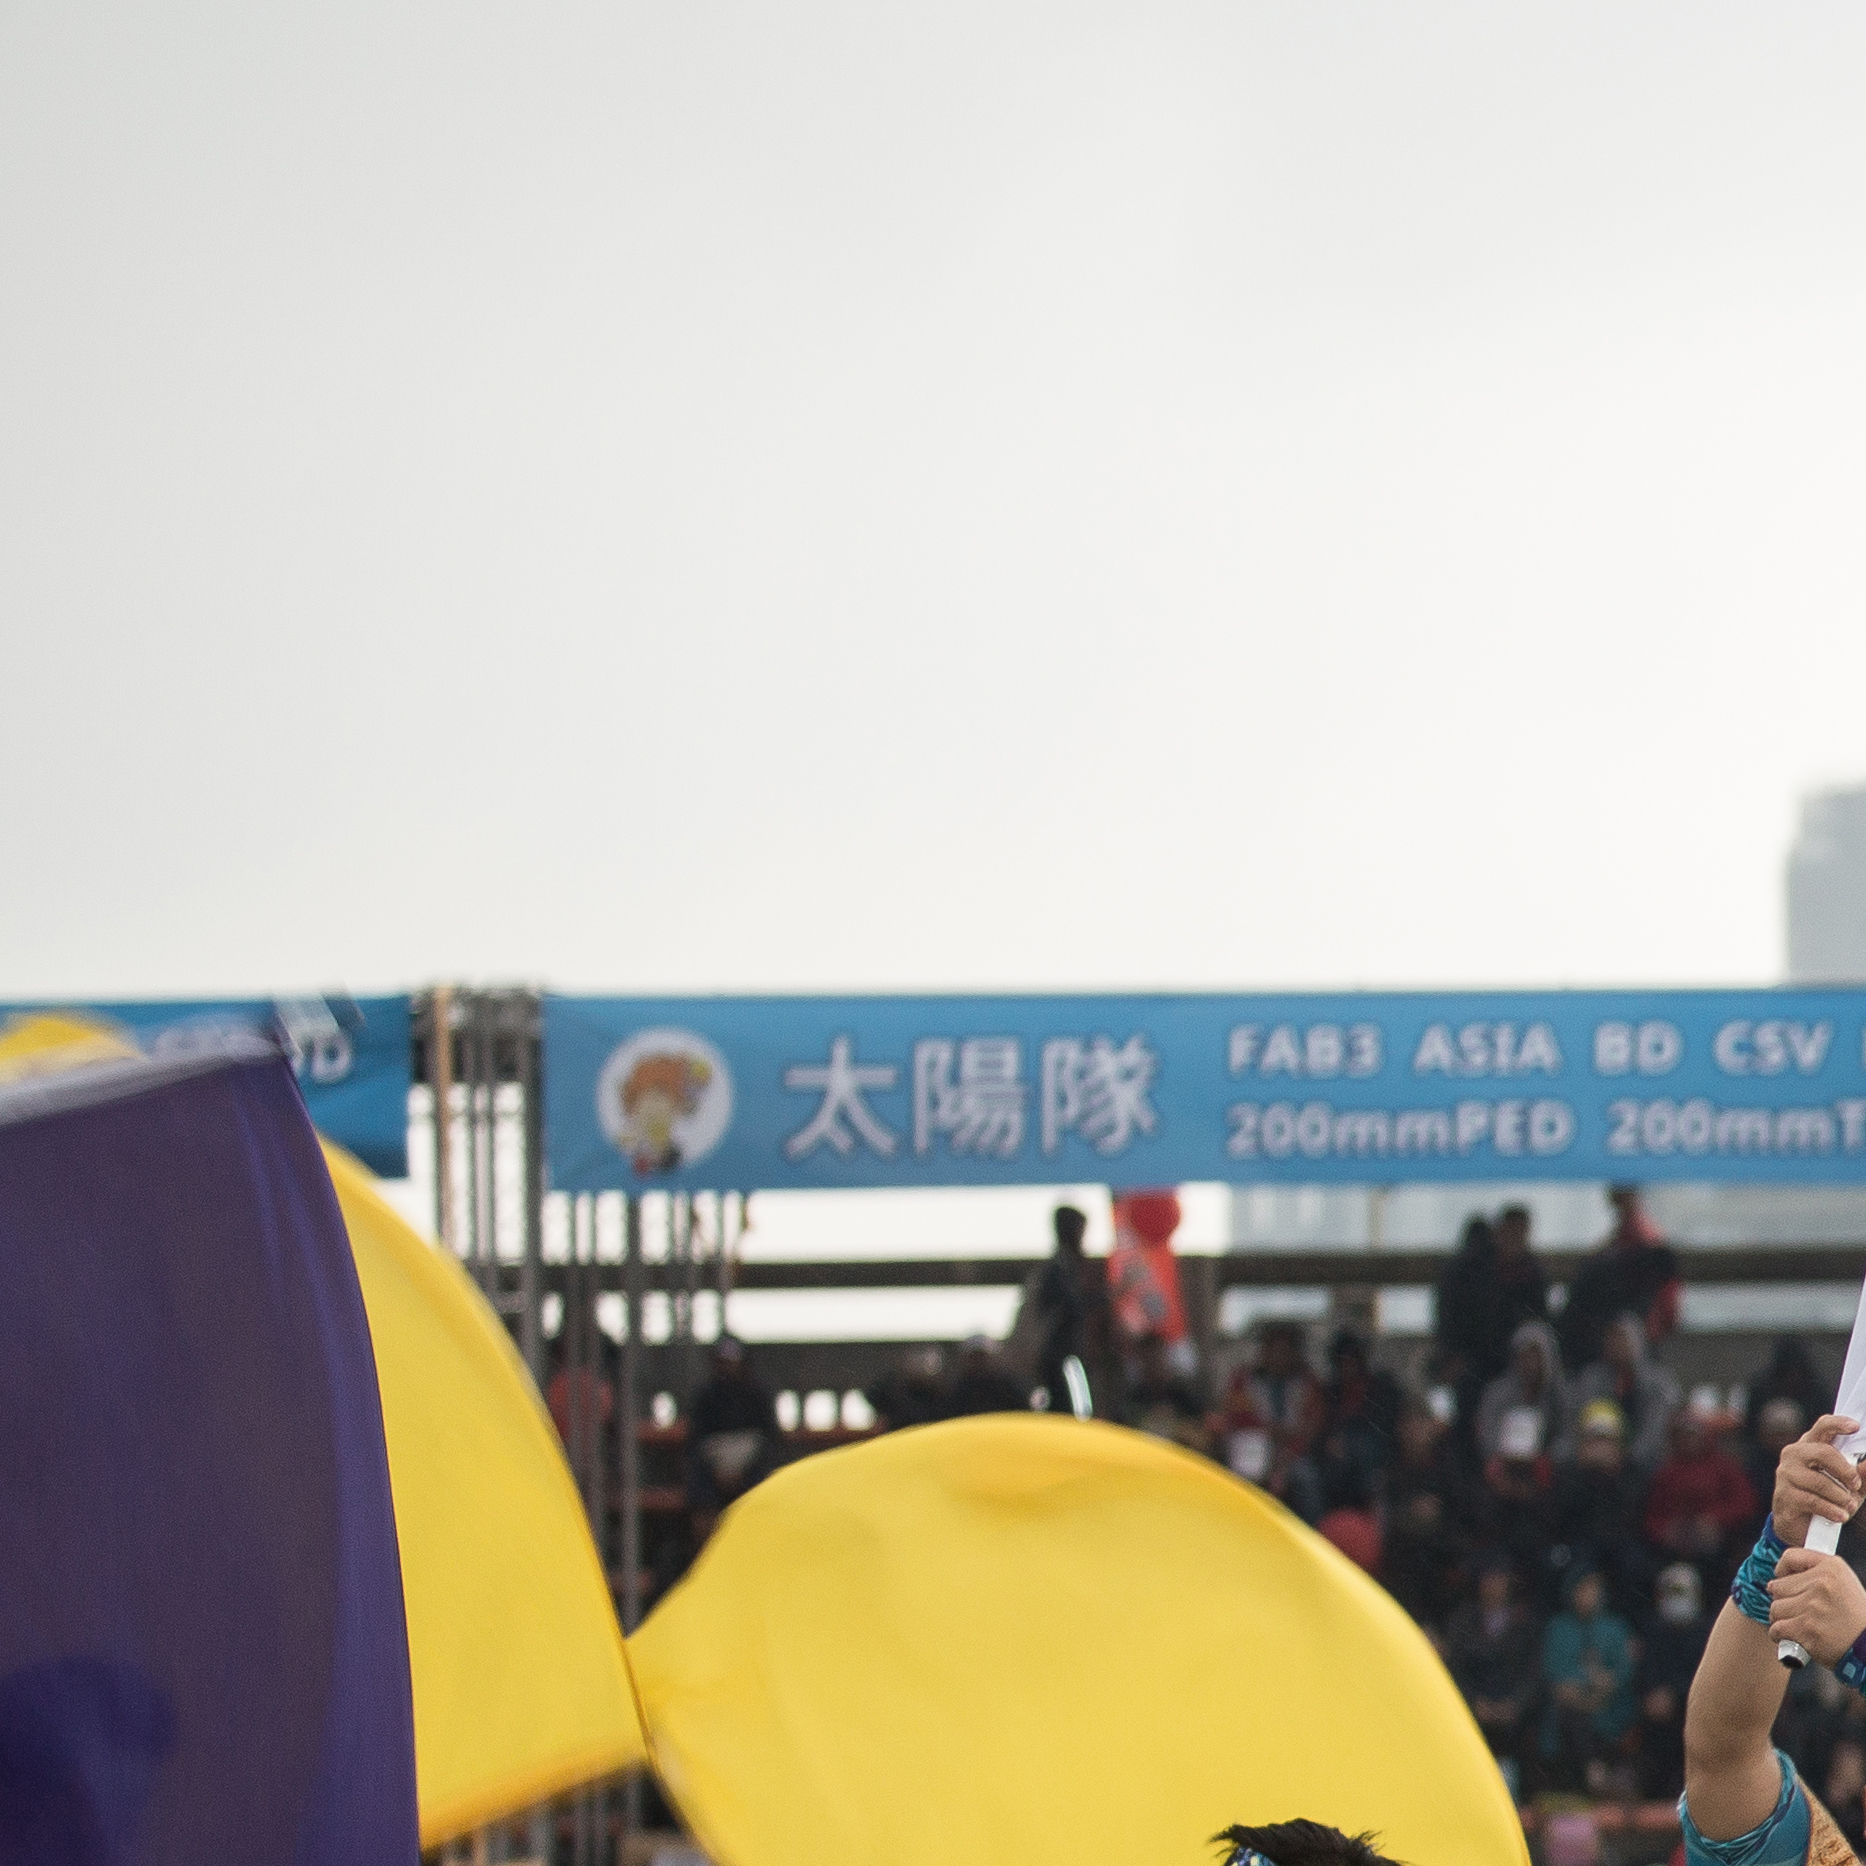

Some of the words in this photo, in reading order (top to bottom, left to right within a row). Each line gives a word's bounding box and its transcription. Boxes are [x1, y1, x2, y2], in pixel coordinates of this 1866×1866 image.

[1227, 1023, 1381, 1077] FAB3
[1413, 1022, 1560, 1077] ASIA
[1596, 1021, 1681, 1076] BD
[1713, 1020, 1833, 1075] CSV
[784, 1031, 1160, 1160] 太陽隊
[1226, 1100, 1574, 1158] 200mmPED
